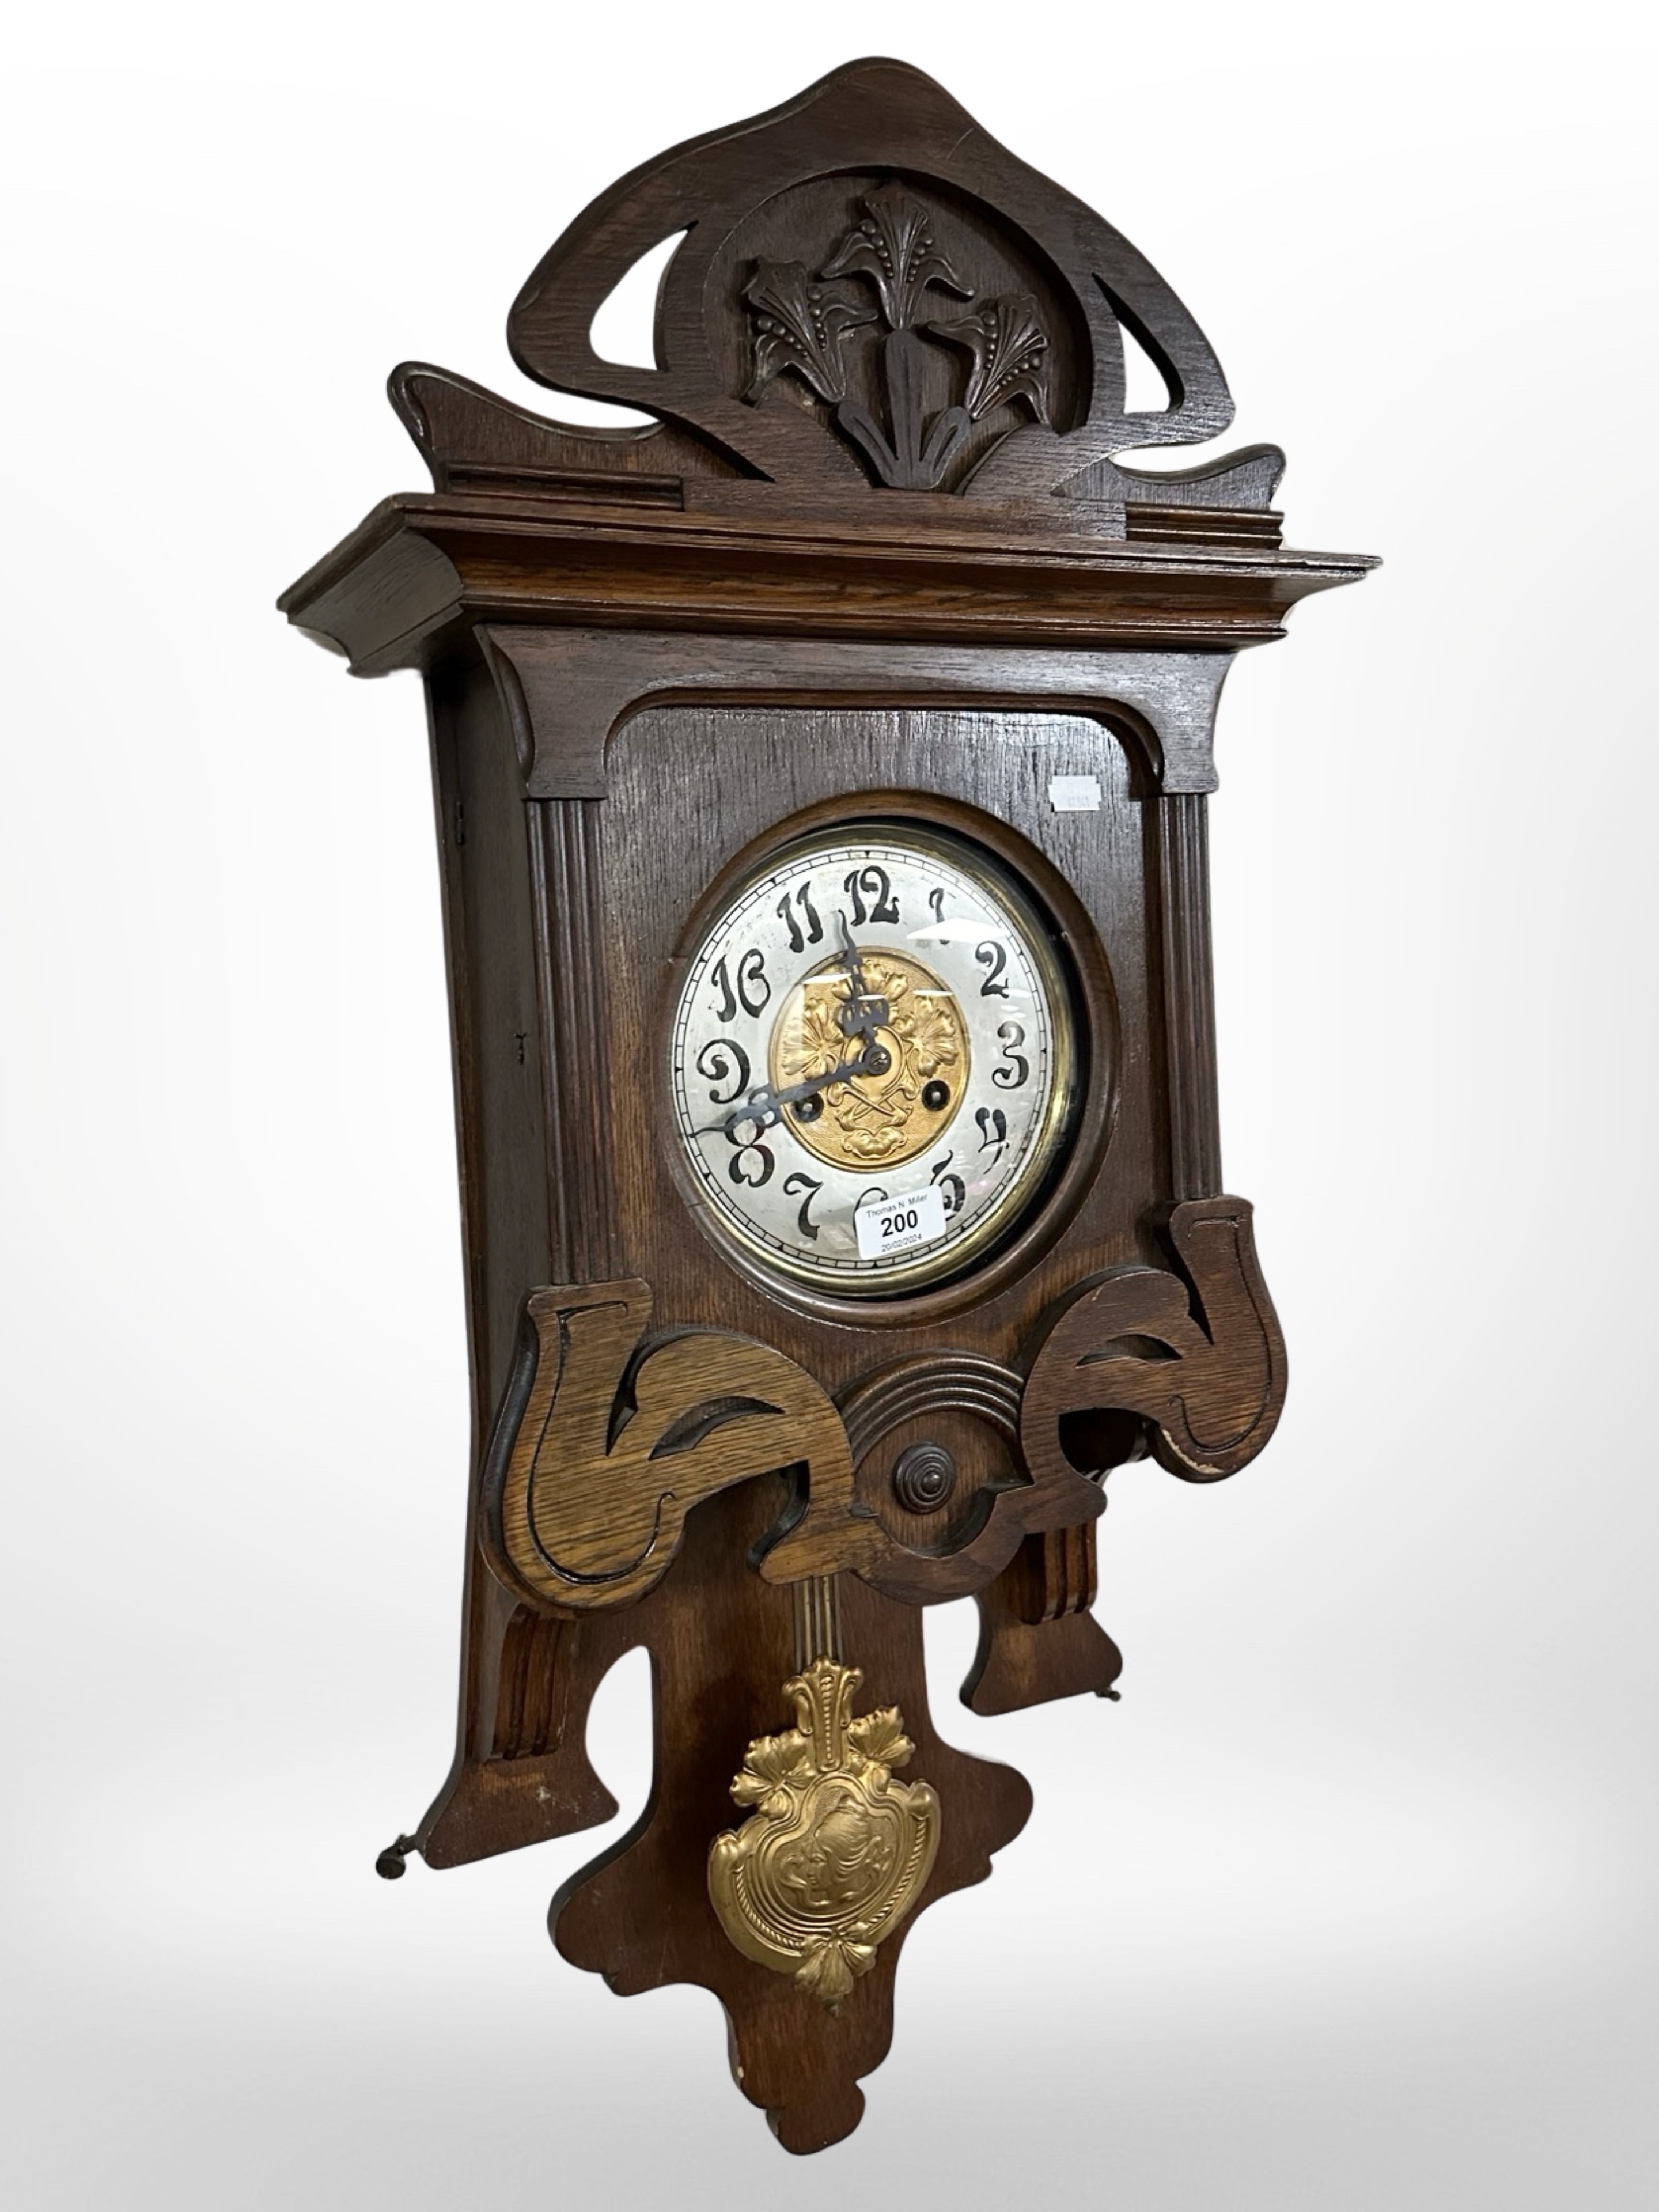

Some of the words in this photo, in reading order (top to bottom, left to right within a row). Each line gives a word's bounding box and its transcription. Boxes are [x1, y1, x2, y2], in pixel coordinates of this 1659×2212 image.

[777, 880, 823, 953] 11
[844, 866, 899, 926] 12
[975, 940, 1010, 999] 2
[697, 1039, 751, 1104] 9
[991, 1020, 1029, 1090] 3
[725, 1115, 775, 1188] 8
[975, 1107, 1010, 1174] 4
[783, 1172, 824, 1240] 7
[865, 1205, 897, 1218] Thomas
[881, 1210, 918, 1237] 200
[881, 1233, 922, 1252] 20/02/2024
